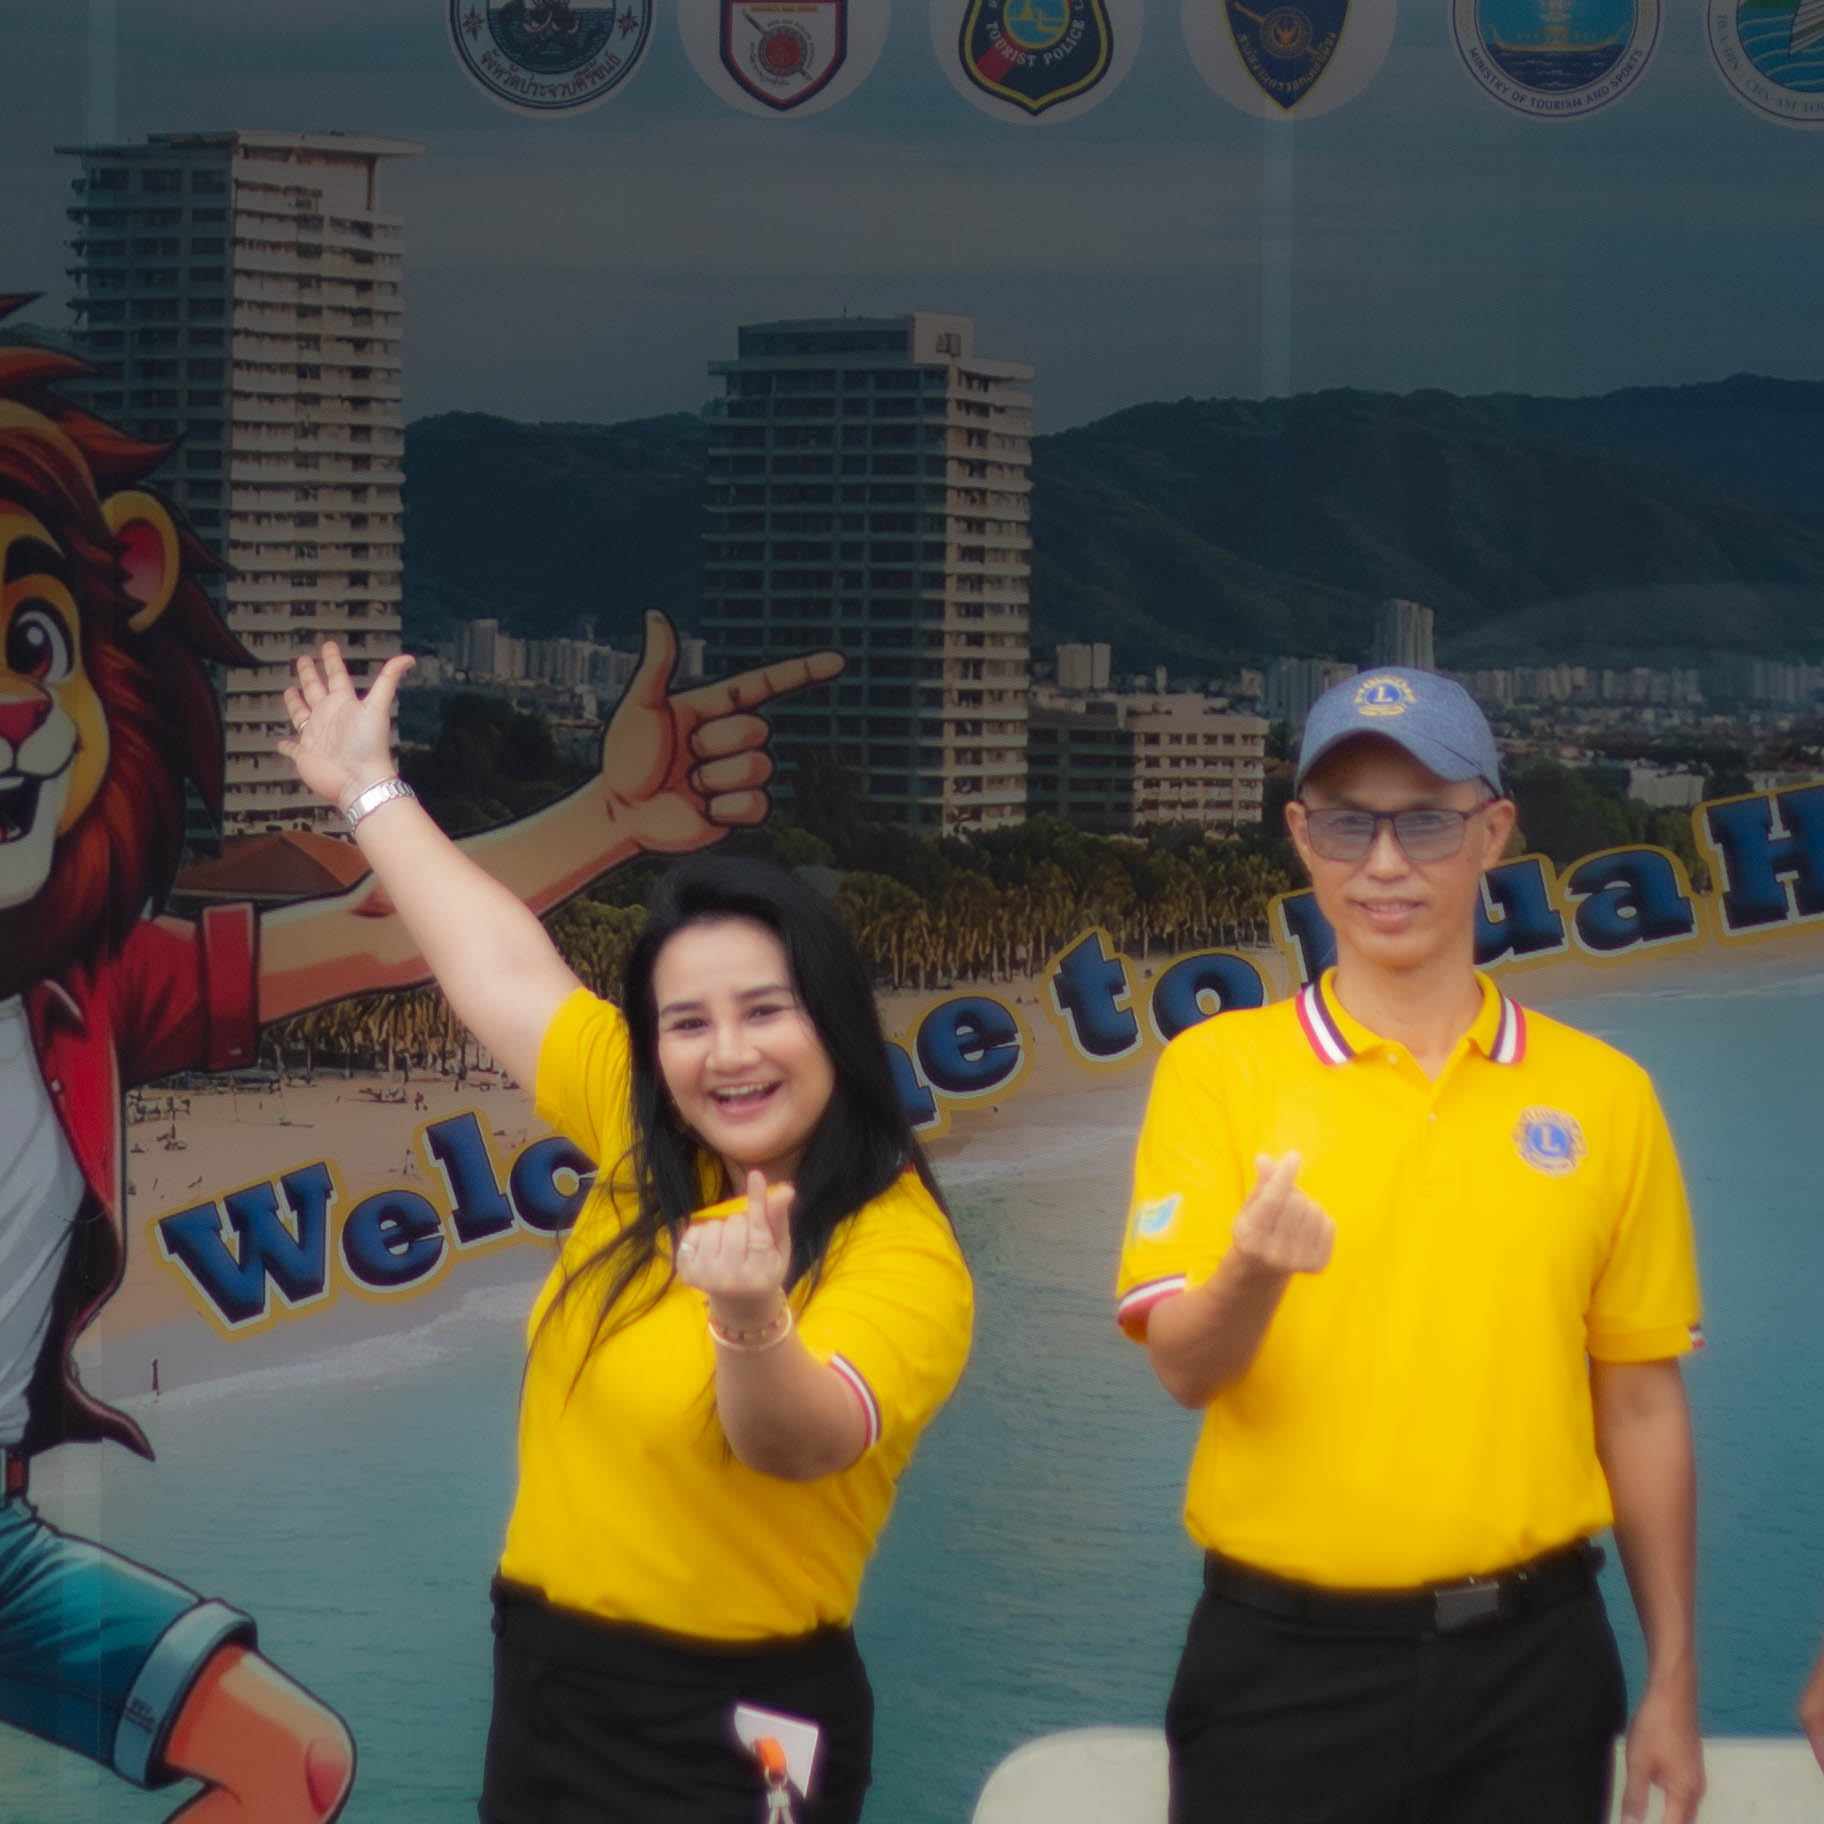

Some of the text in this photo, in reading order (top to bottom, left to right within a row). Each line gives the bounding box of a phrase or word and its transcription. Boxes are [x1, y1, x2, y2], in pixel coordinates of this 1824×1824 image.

[985, 18, 1086, 68] TOURIST POLICE
[1470, 48, 1644, 112] MINISTRY OF TOURISM AND SPORTS
[159, 996, 1021, 1325] Welce
[1053, 932, 1265, 1059] to
